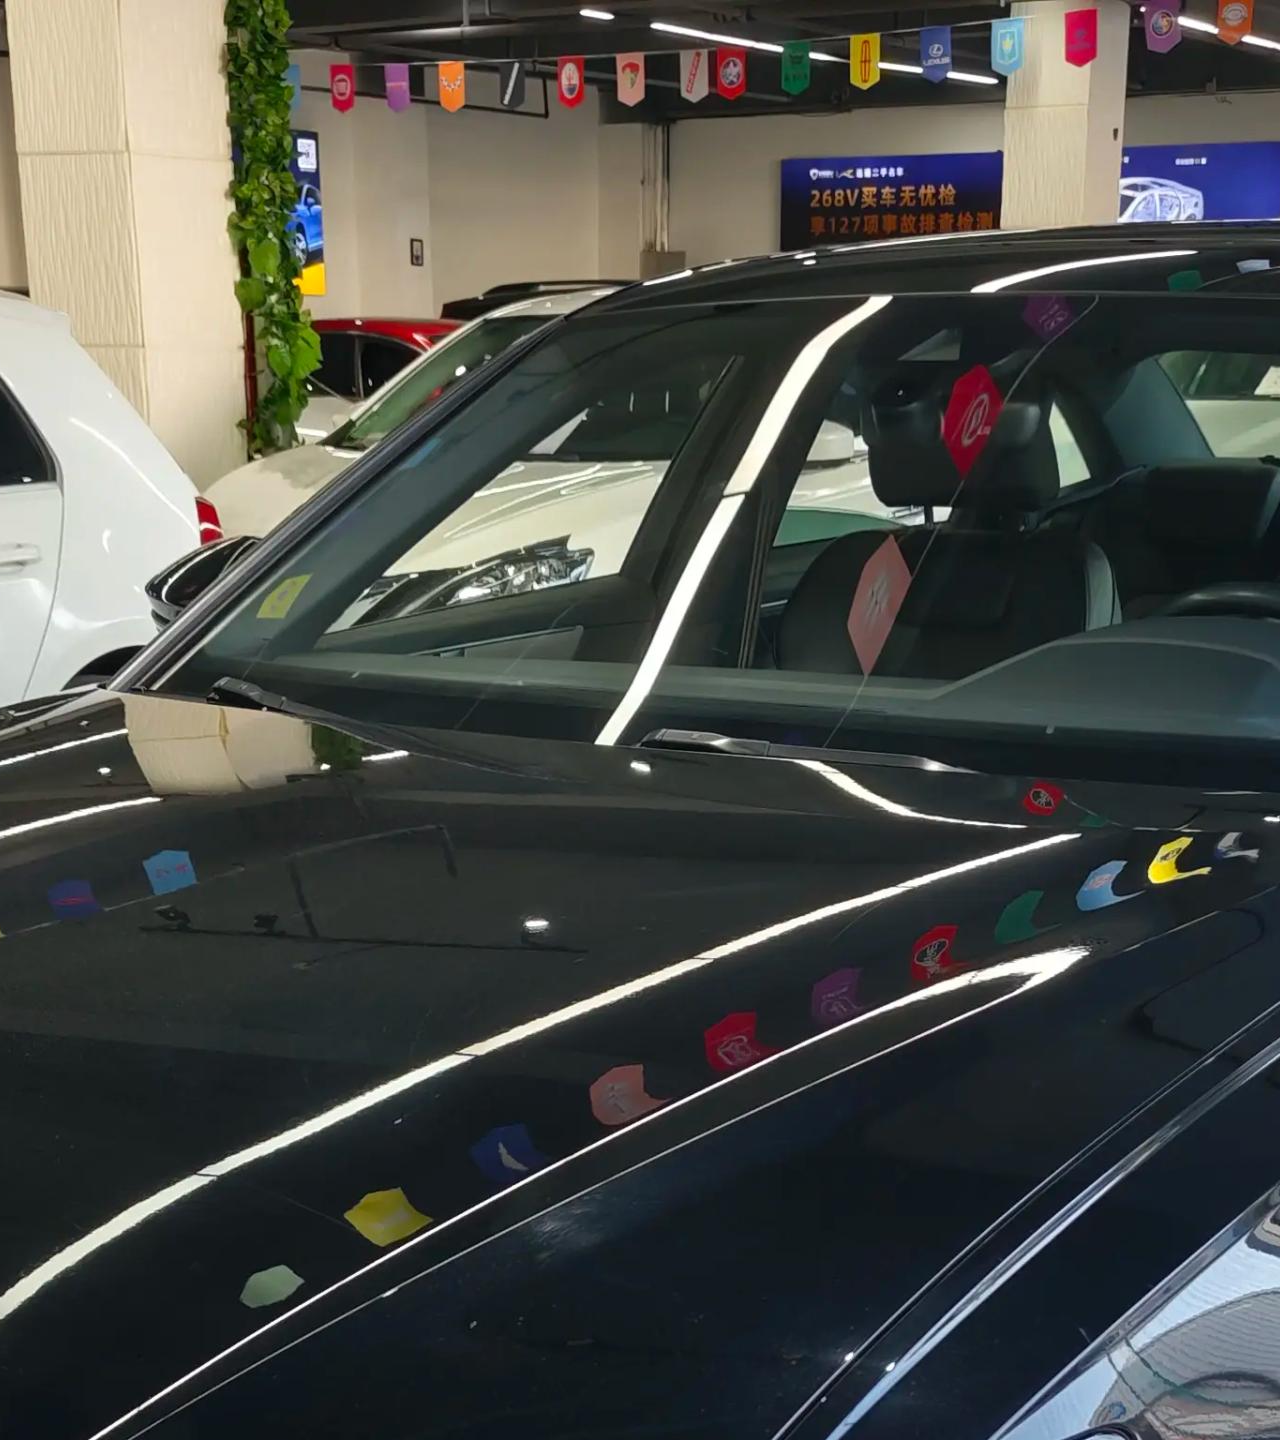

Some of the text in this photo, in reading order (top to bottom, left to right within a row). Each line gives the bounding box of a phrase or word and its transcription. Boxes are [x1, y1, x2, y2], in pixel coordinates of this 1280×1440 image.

[810, 184, 956, 208] 268V买车无忧检
